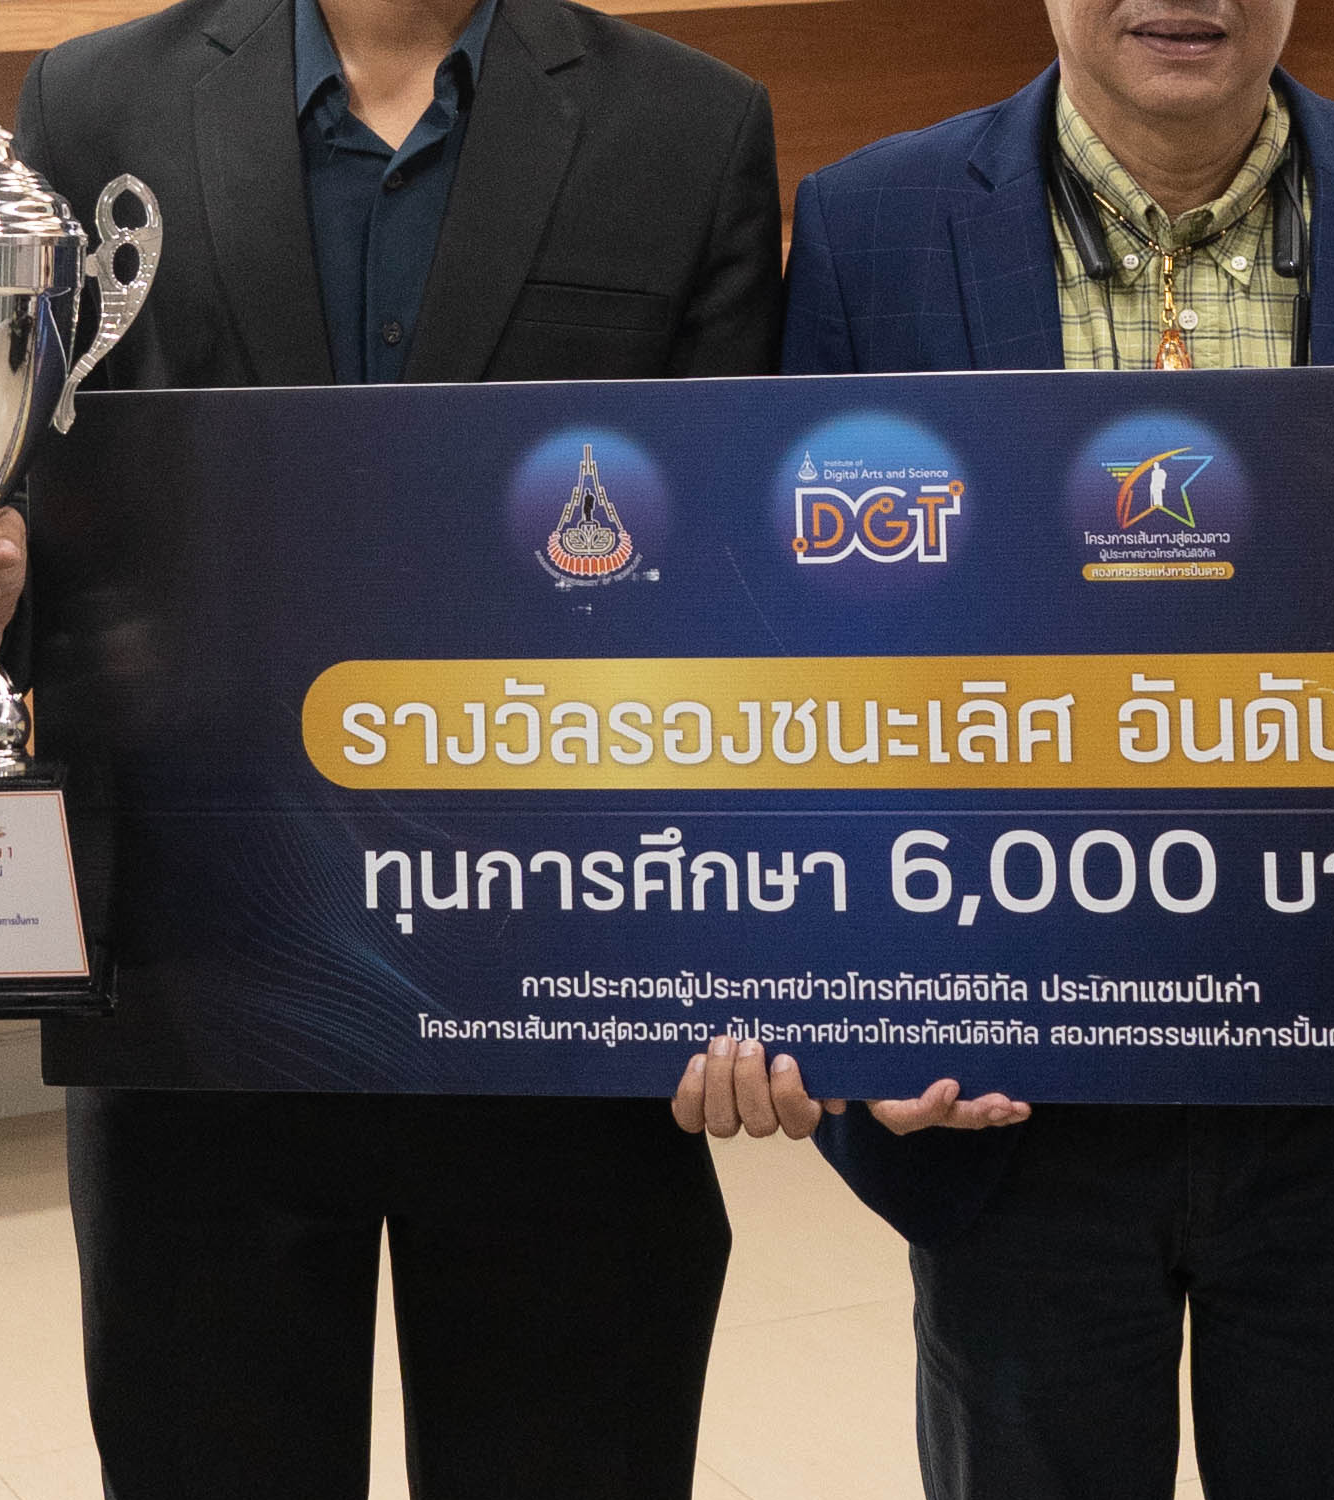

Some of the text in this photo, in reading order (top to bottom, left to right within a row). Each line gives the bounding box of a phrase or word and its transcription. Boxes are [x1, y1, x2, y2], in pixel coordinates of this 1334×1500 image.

[823, 467, 949, 482] Digital Arts and Science
[792, 480, 965, 564] DGT
[1084, 530, 1231, 547] โครงการเส้นทางสู่ดวงดาว
[342, 677, 1075, 766] รางวัลรองชนะเลิศ
[365, 827, 847, 934] ทุนการศึกษา
[890, 829, 1217, 926] 6,000
[521, 970, 1261, 1007] การประกวดผู้ประกาศข่าวโทรทัศน์ดิจิทัล ประเภทแชมป์เก่า
[727, 1016, 1039, 1045] ผ้ประกาศข่าวโทรทัศน์ดิจิทัล
